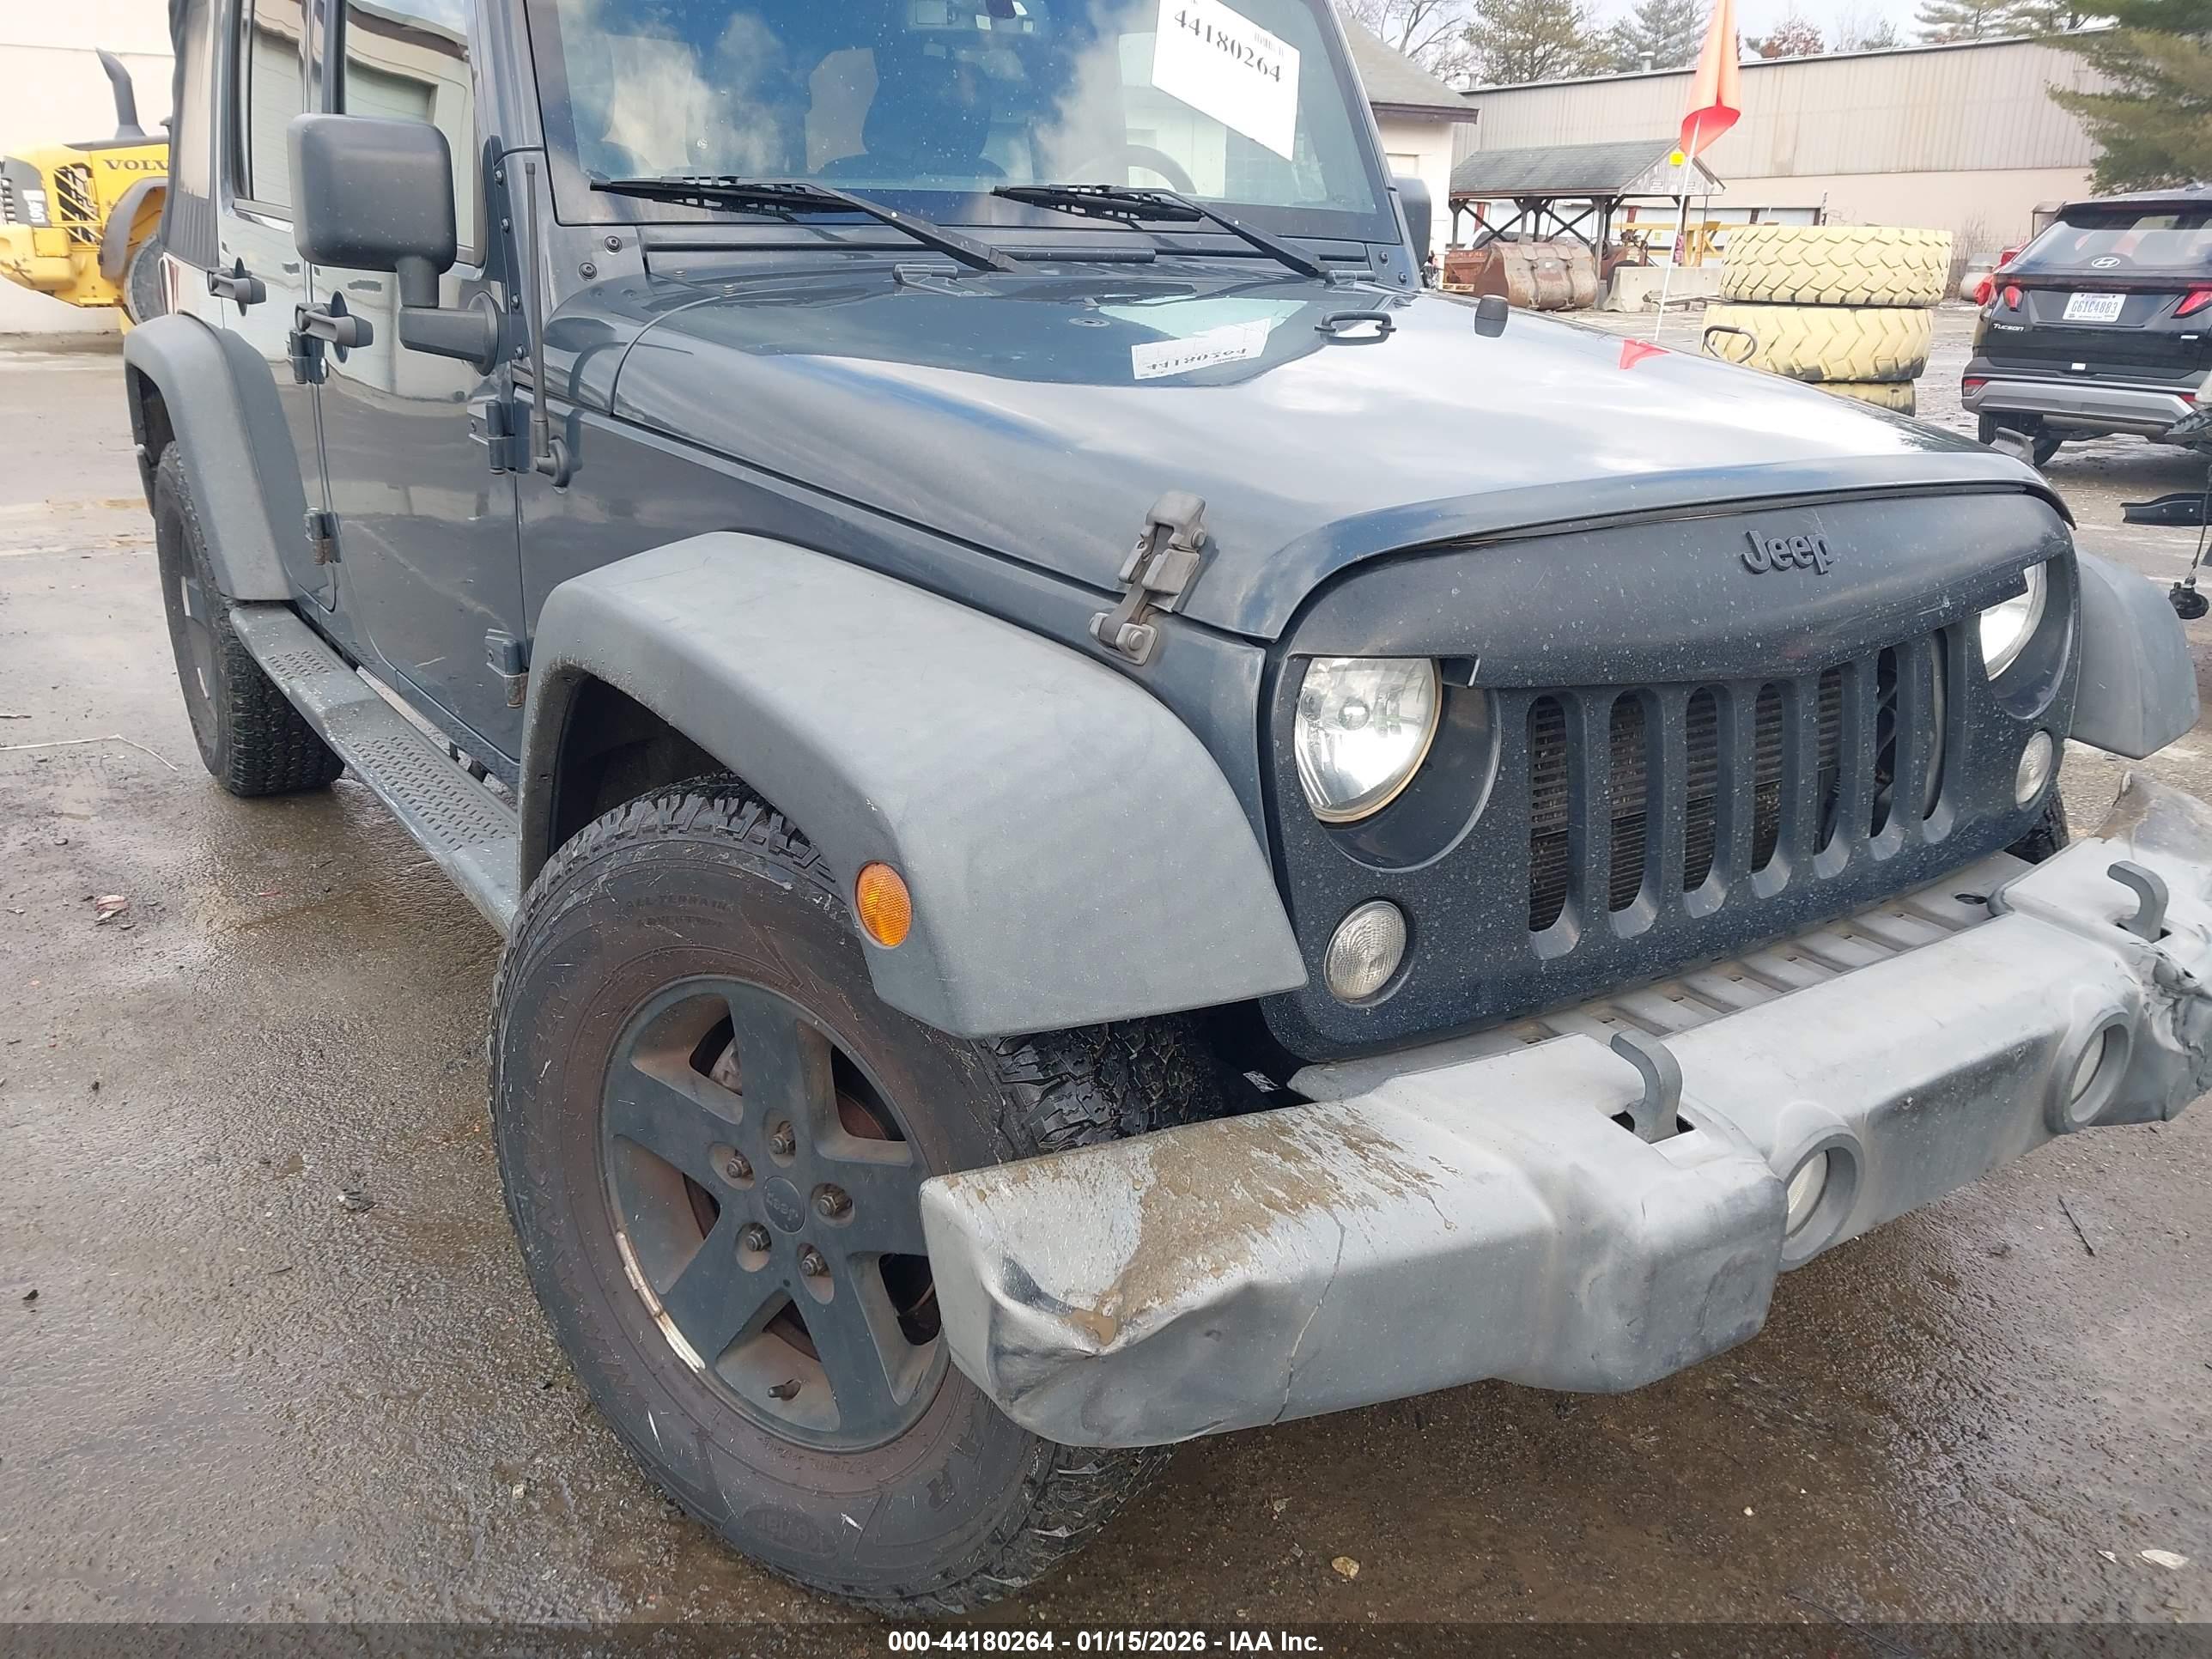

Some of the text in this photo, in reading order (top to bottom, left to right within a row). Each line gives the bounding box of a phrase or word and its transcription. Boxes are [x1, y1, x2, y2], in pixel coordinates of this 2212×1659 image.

[1174, 9, 1281, 83] 44180264
[103, 159, 169, 171] VOLV
[1740, 529, 1835, 576] Jeep
